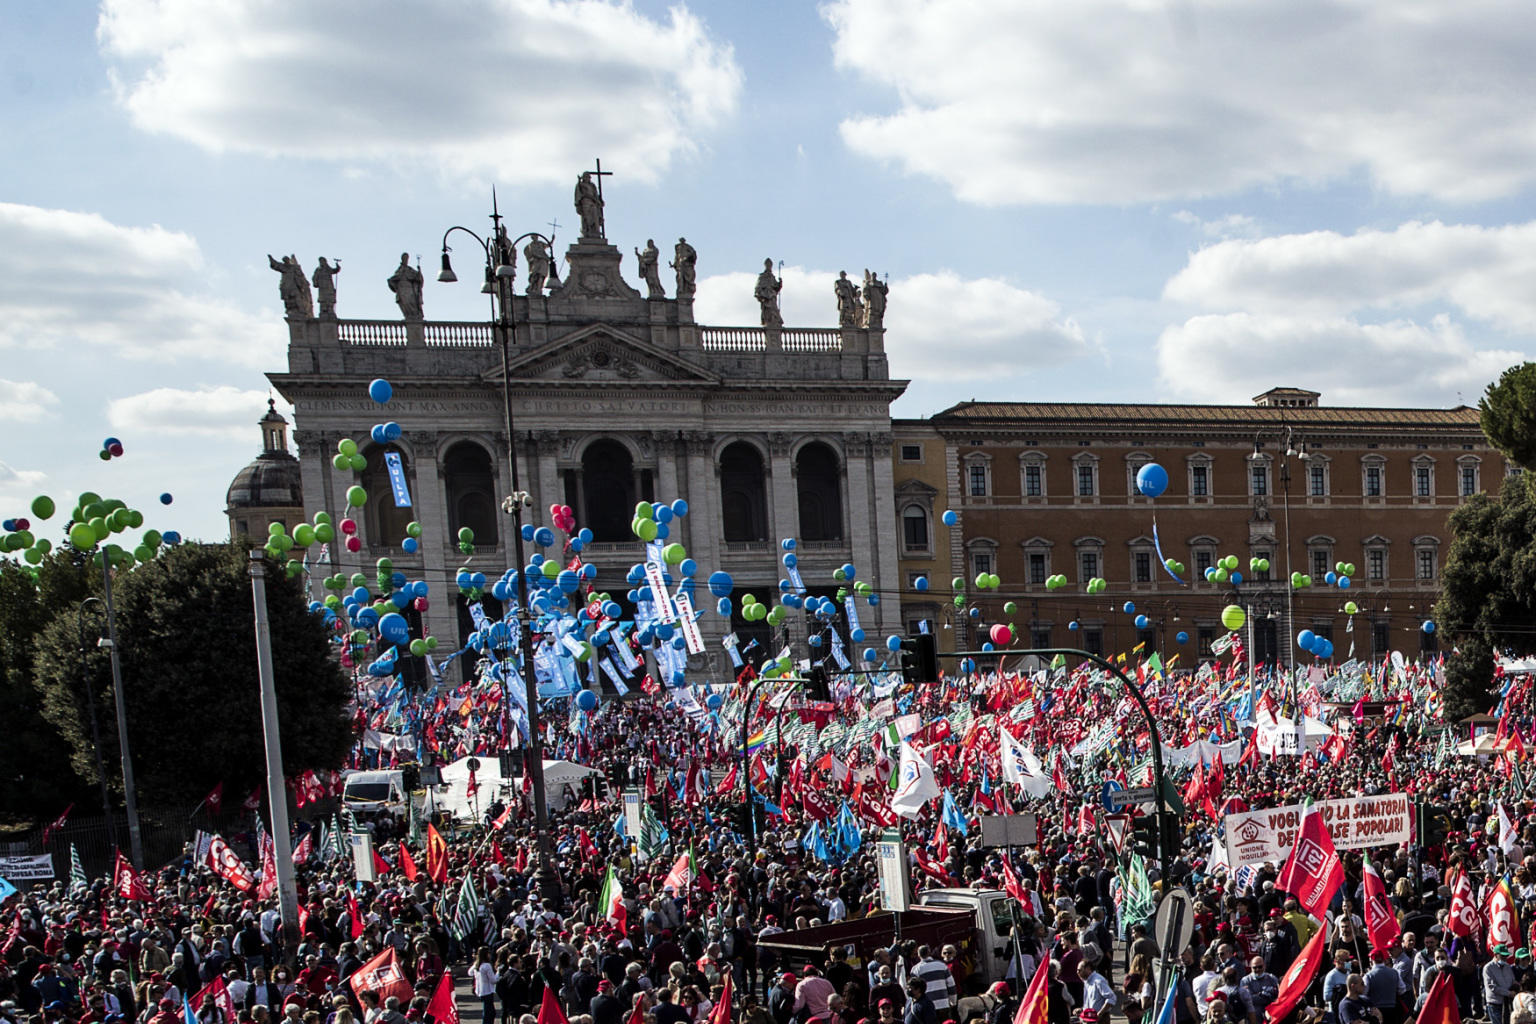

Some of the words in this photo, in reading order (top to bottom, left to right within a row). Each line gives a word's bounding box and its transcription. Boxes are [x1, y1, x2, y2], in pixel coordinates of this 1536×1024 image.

[420, 401, 448, 411] MAX
[391, 468, 407, 505] UILPA
[862, 791, 893, 825] CGIL
[1337, 803, 1350, 820] LA
[1353, 799, 1406, 819] SANATORIA
[1356, 817, 1404, 837] POPOLARI
[1240, 844, 1265, 853] UNIONE
